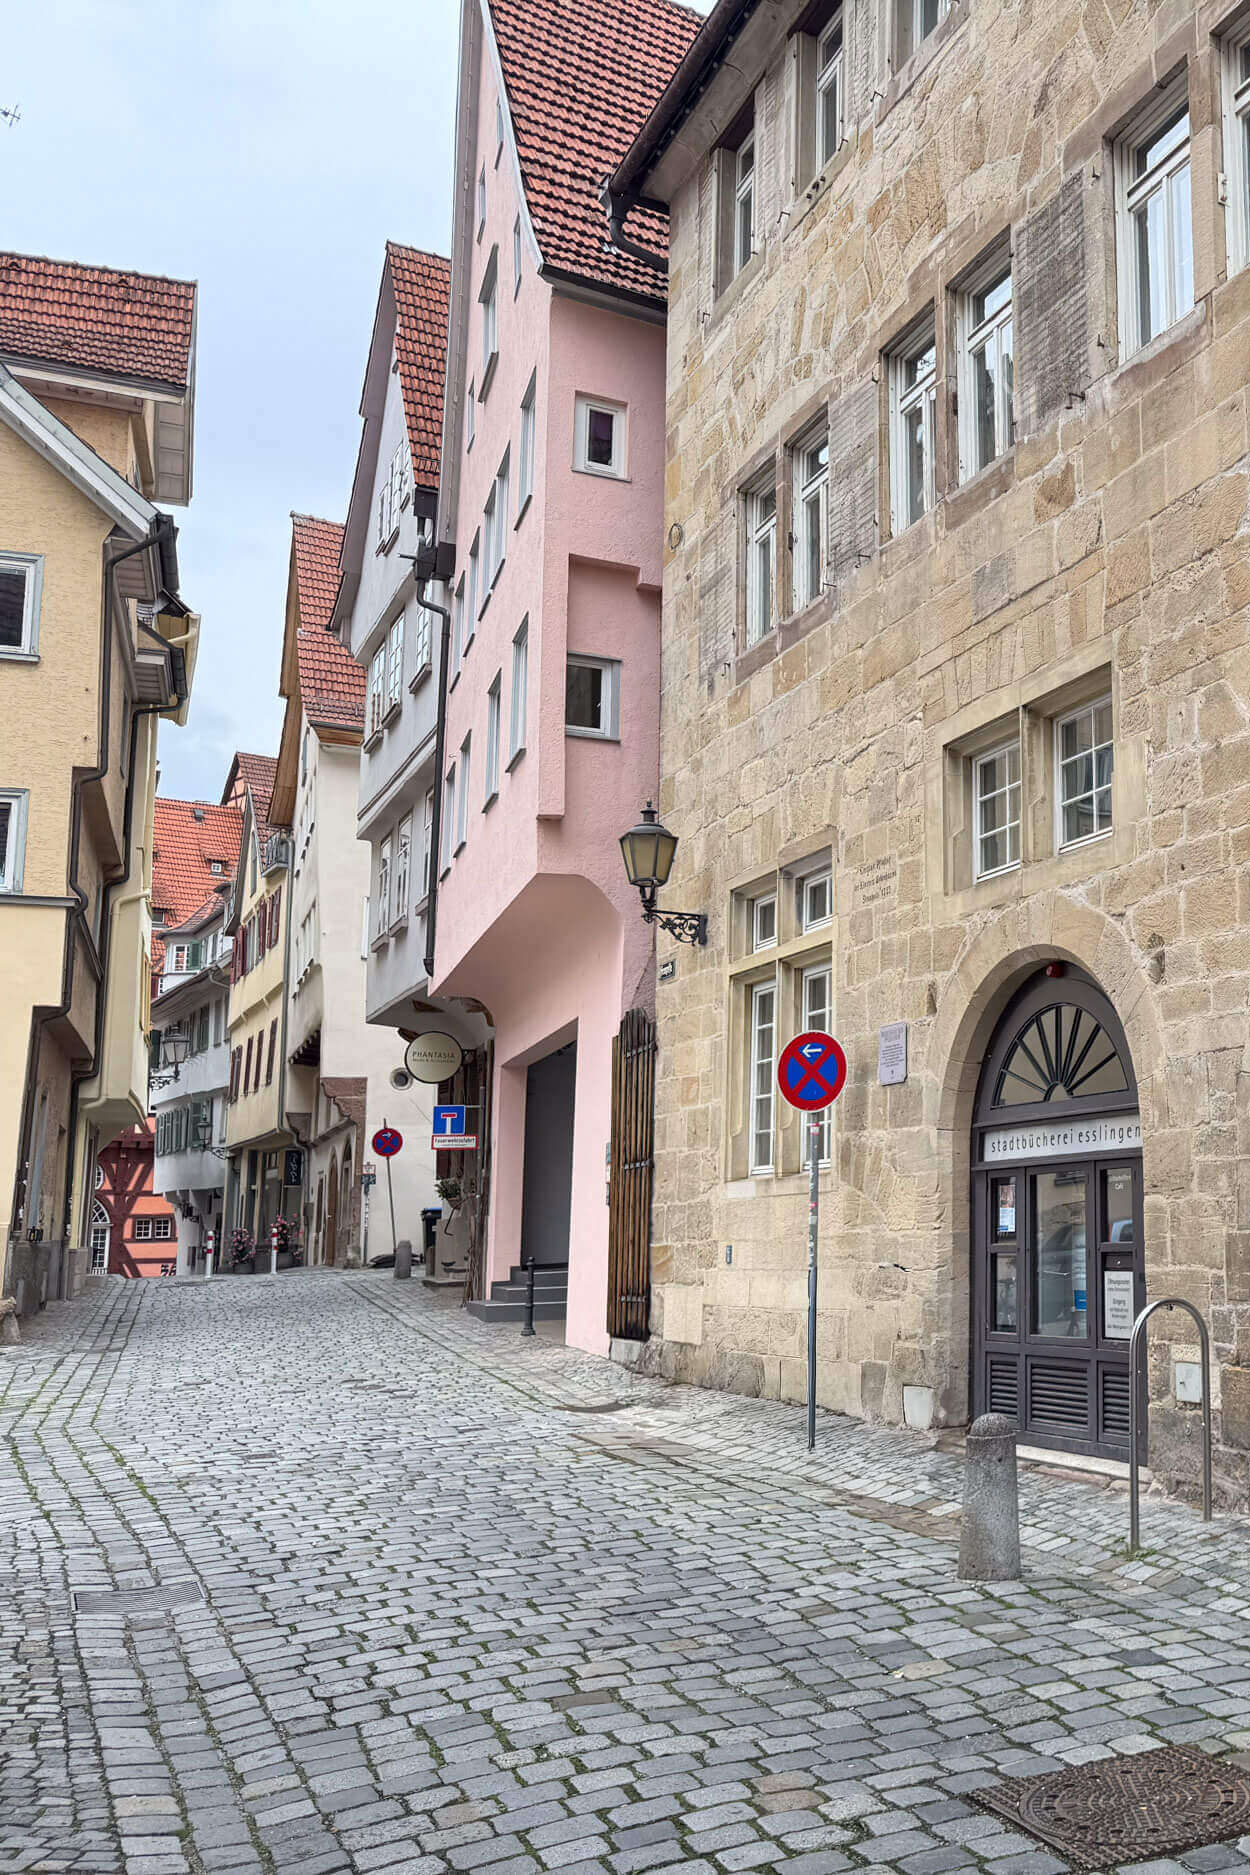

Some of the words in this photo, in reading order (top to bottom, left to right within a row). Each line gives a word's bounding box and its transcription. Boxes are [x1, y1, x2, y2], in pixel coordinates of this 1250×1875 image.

[412, 1050, 456, 1060] PHANTASIA
[991, 1128, 1074, 1153] stadtbücherei
[1078, 1123, 1141, 1144] esslingen
